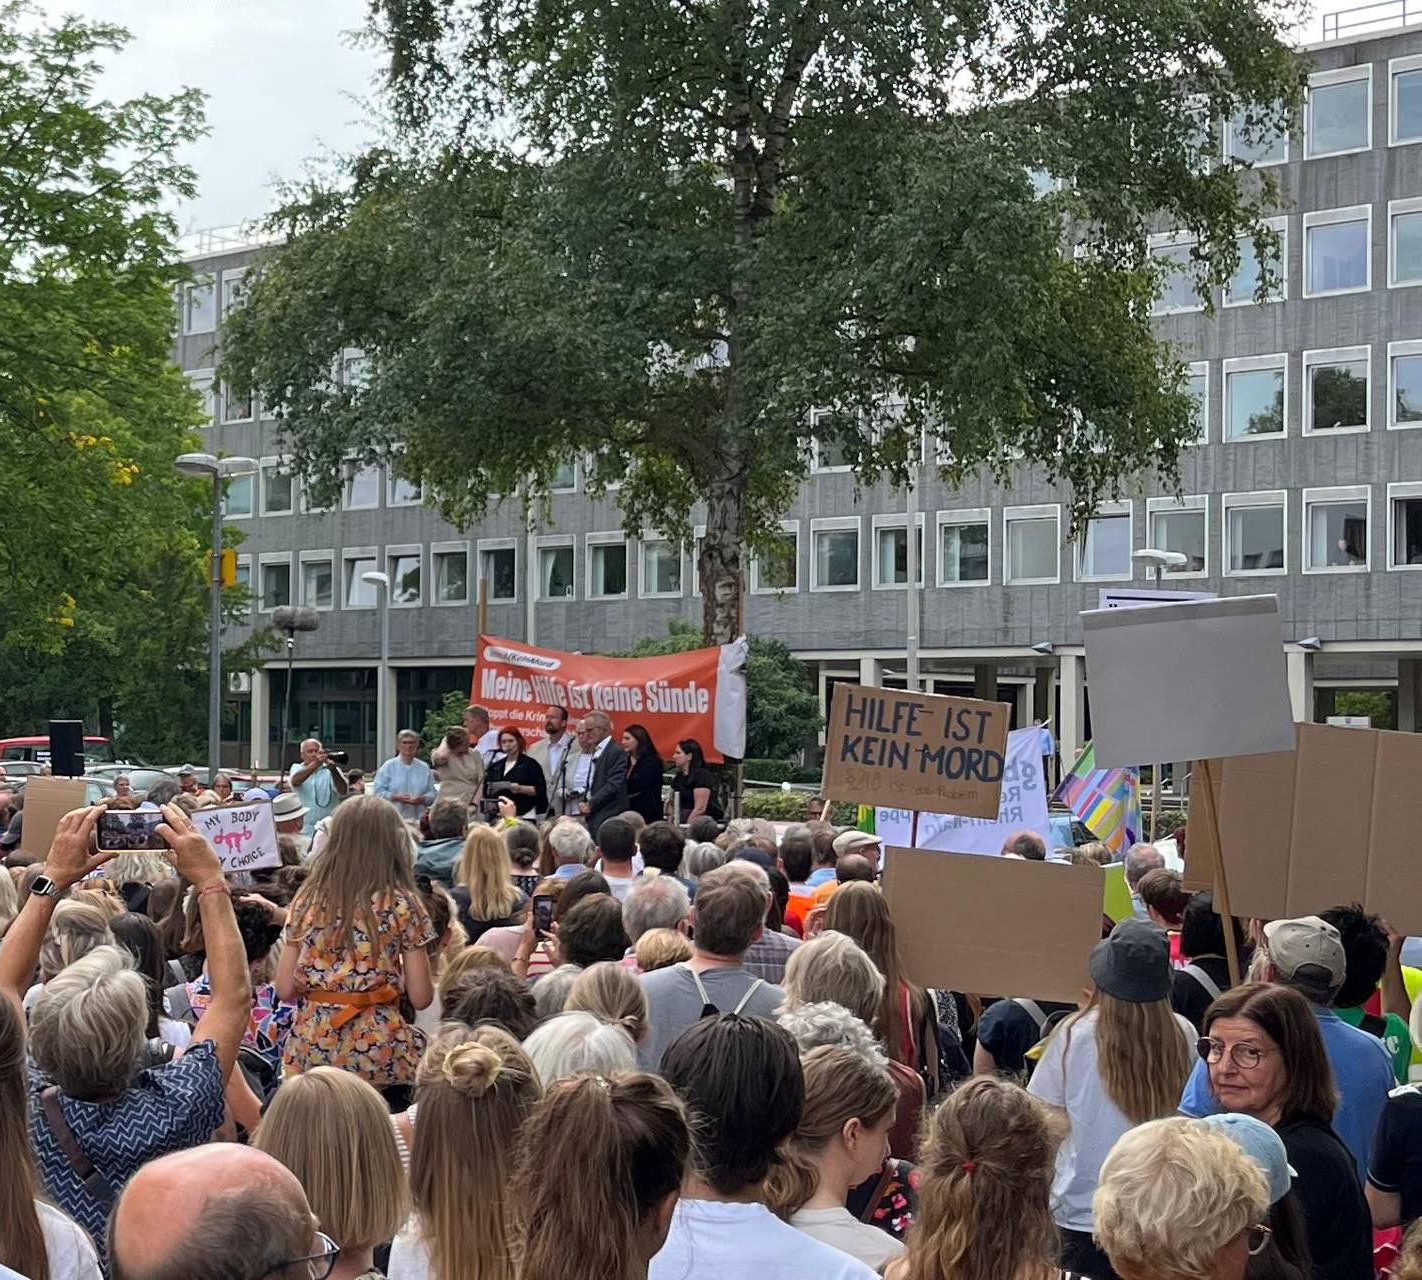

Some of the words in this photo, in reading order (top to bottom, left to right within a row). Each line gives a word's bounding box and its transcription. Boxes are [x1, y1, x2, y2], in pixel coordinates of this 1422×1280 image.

[481, 668, 533, 703] Meine
[530, 675, 566, 708] Hilfe
[567, 679, 590, 711] ist
[592, 681, 642, 713] keine
[645, 681, 709, 714] Sünde
[844, 689, 925, 737] HILFE
[944, 707, 992, 744] IST
[841, 734, 910, 771] KEIN
[920, 744, 1004, 783] MORD
[204, 814, 221, 830] MY
[231, 811, 260, 824] BODY
[230, 846, 266, 868] CHOICE
